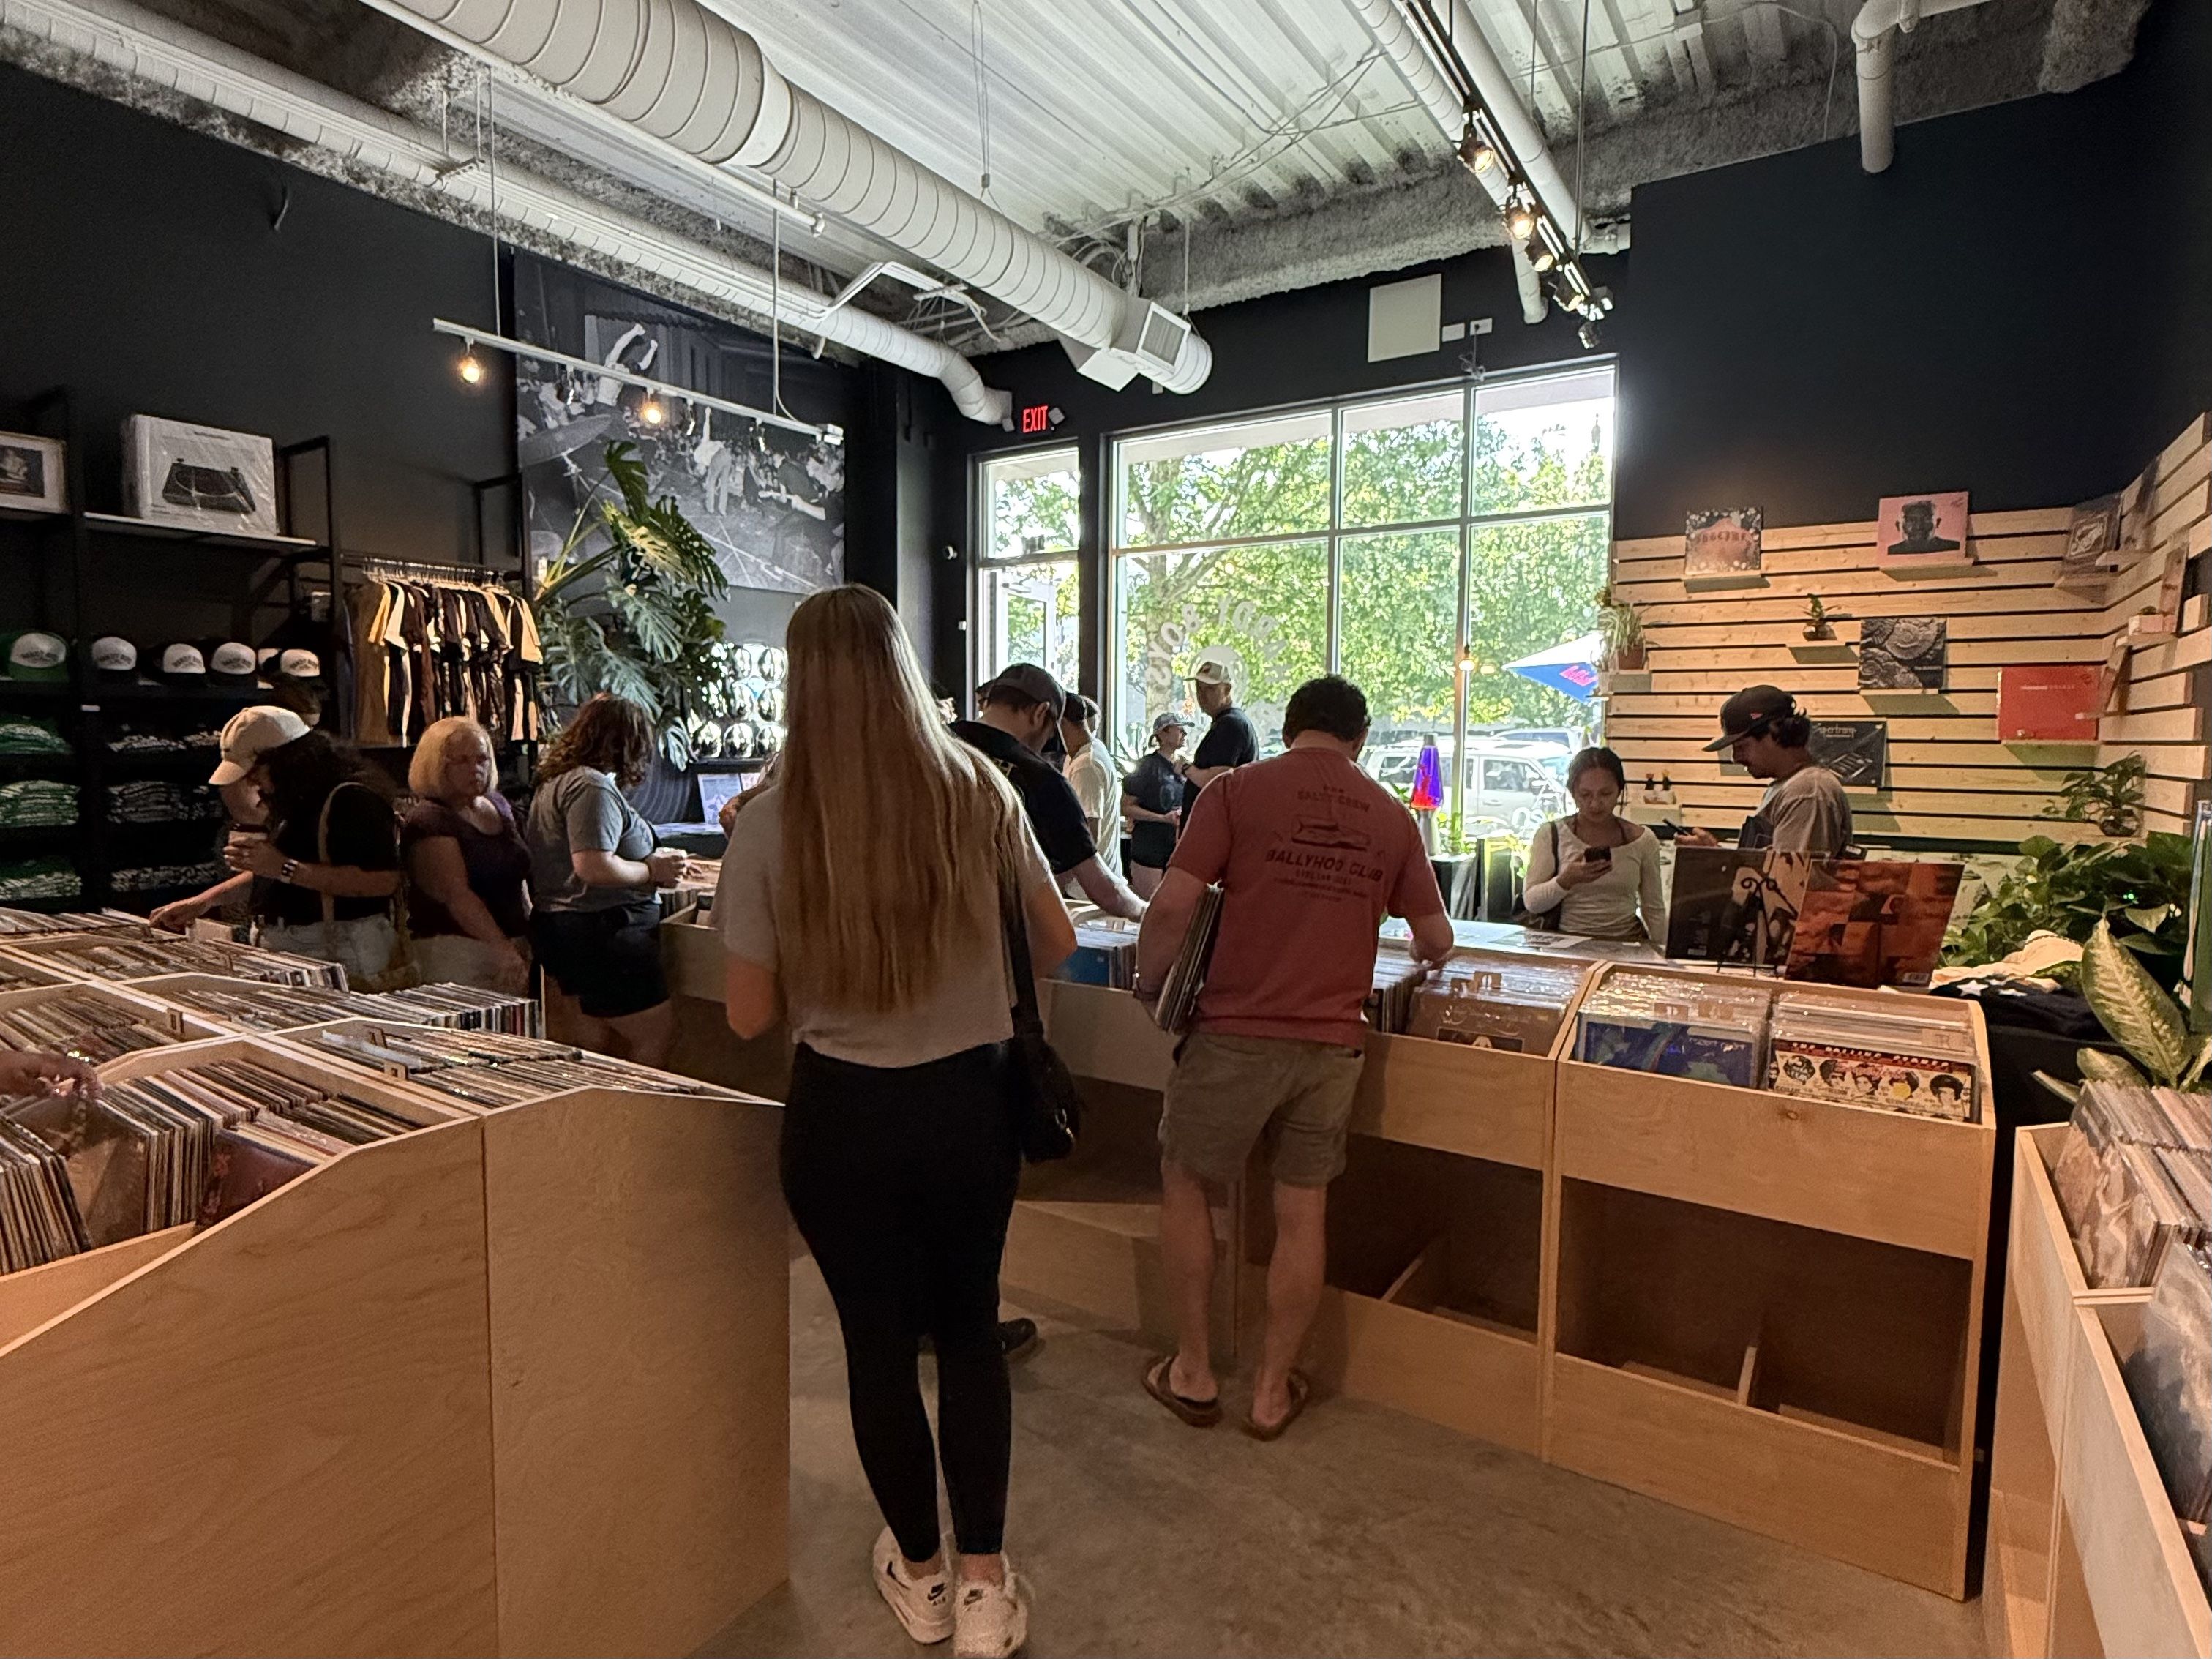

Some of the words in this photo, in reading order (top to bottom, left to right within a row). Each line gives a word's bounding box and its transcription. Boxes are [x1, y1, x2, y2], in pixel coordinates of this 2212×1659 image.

[1023, 405, 1048, 433] EXIT
[1338, 795, 1371, 812] CREW
[1265, 849, 1344, 872] BALLYHOO
[1349, 862, 1384, 883] CLUB
